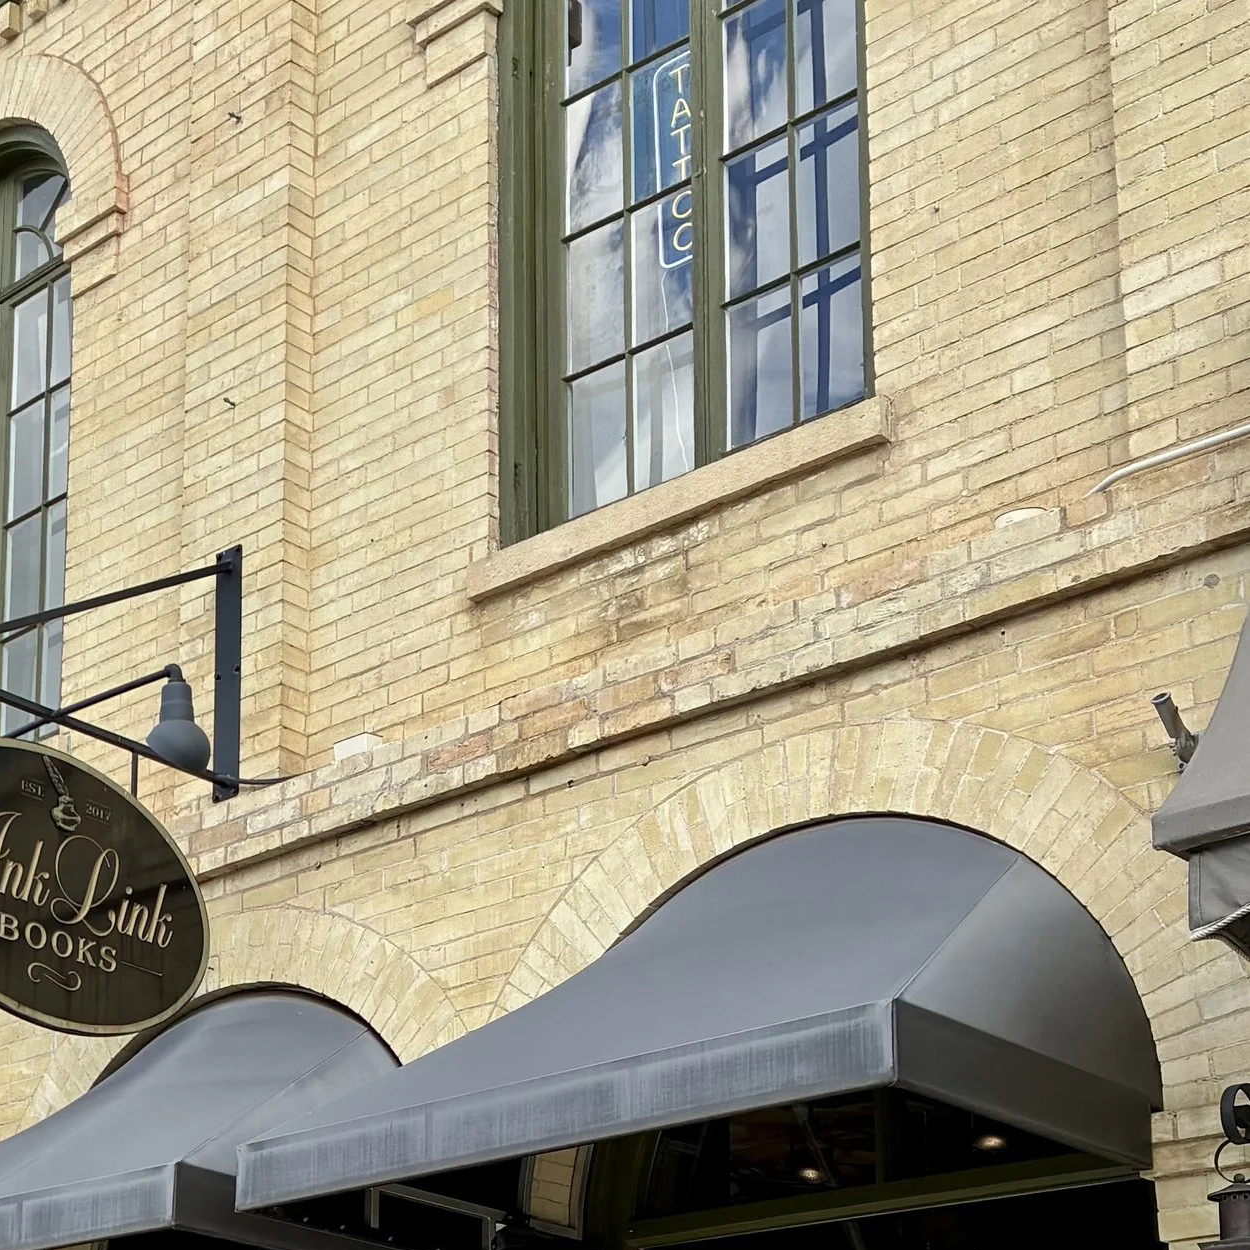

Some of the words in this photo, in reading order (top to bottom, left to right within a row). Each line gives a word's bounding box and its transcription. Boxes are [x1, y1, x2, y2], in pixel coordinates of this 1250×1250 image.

[669, 62, 693, 252] TATTOO
[85, 803, 111, 821] 2017
[51, 835, 174, 949] Link
